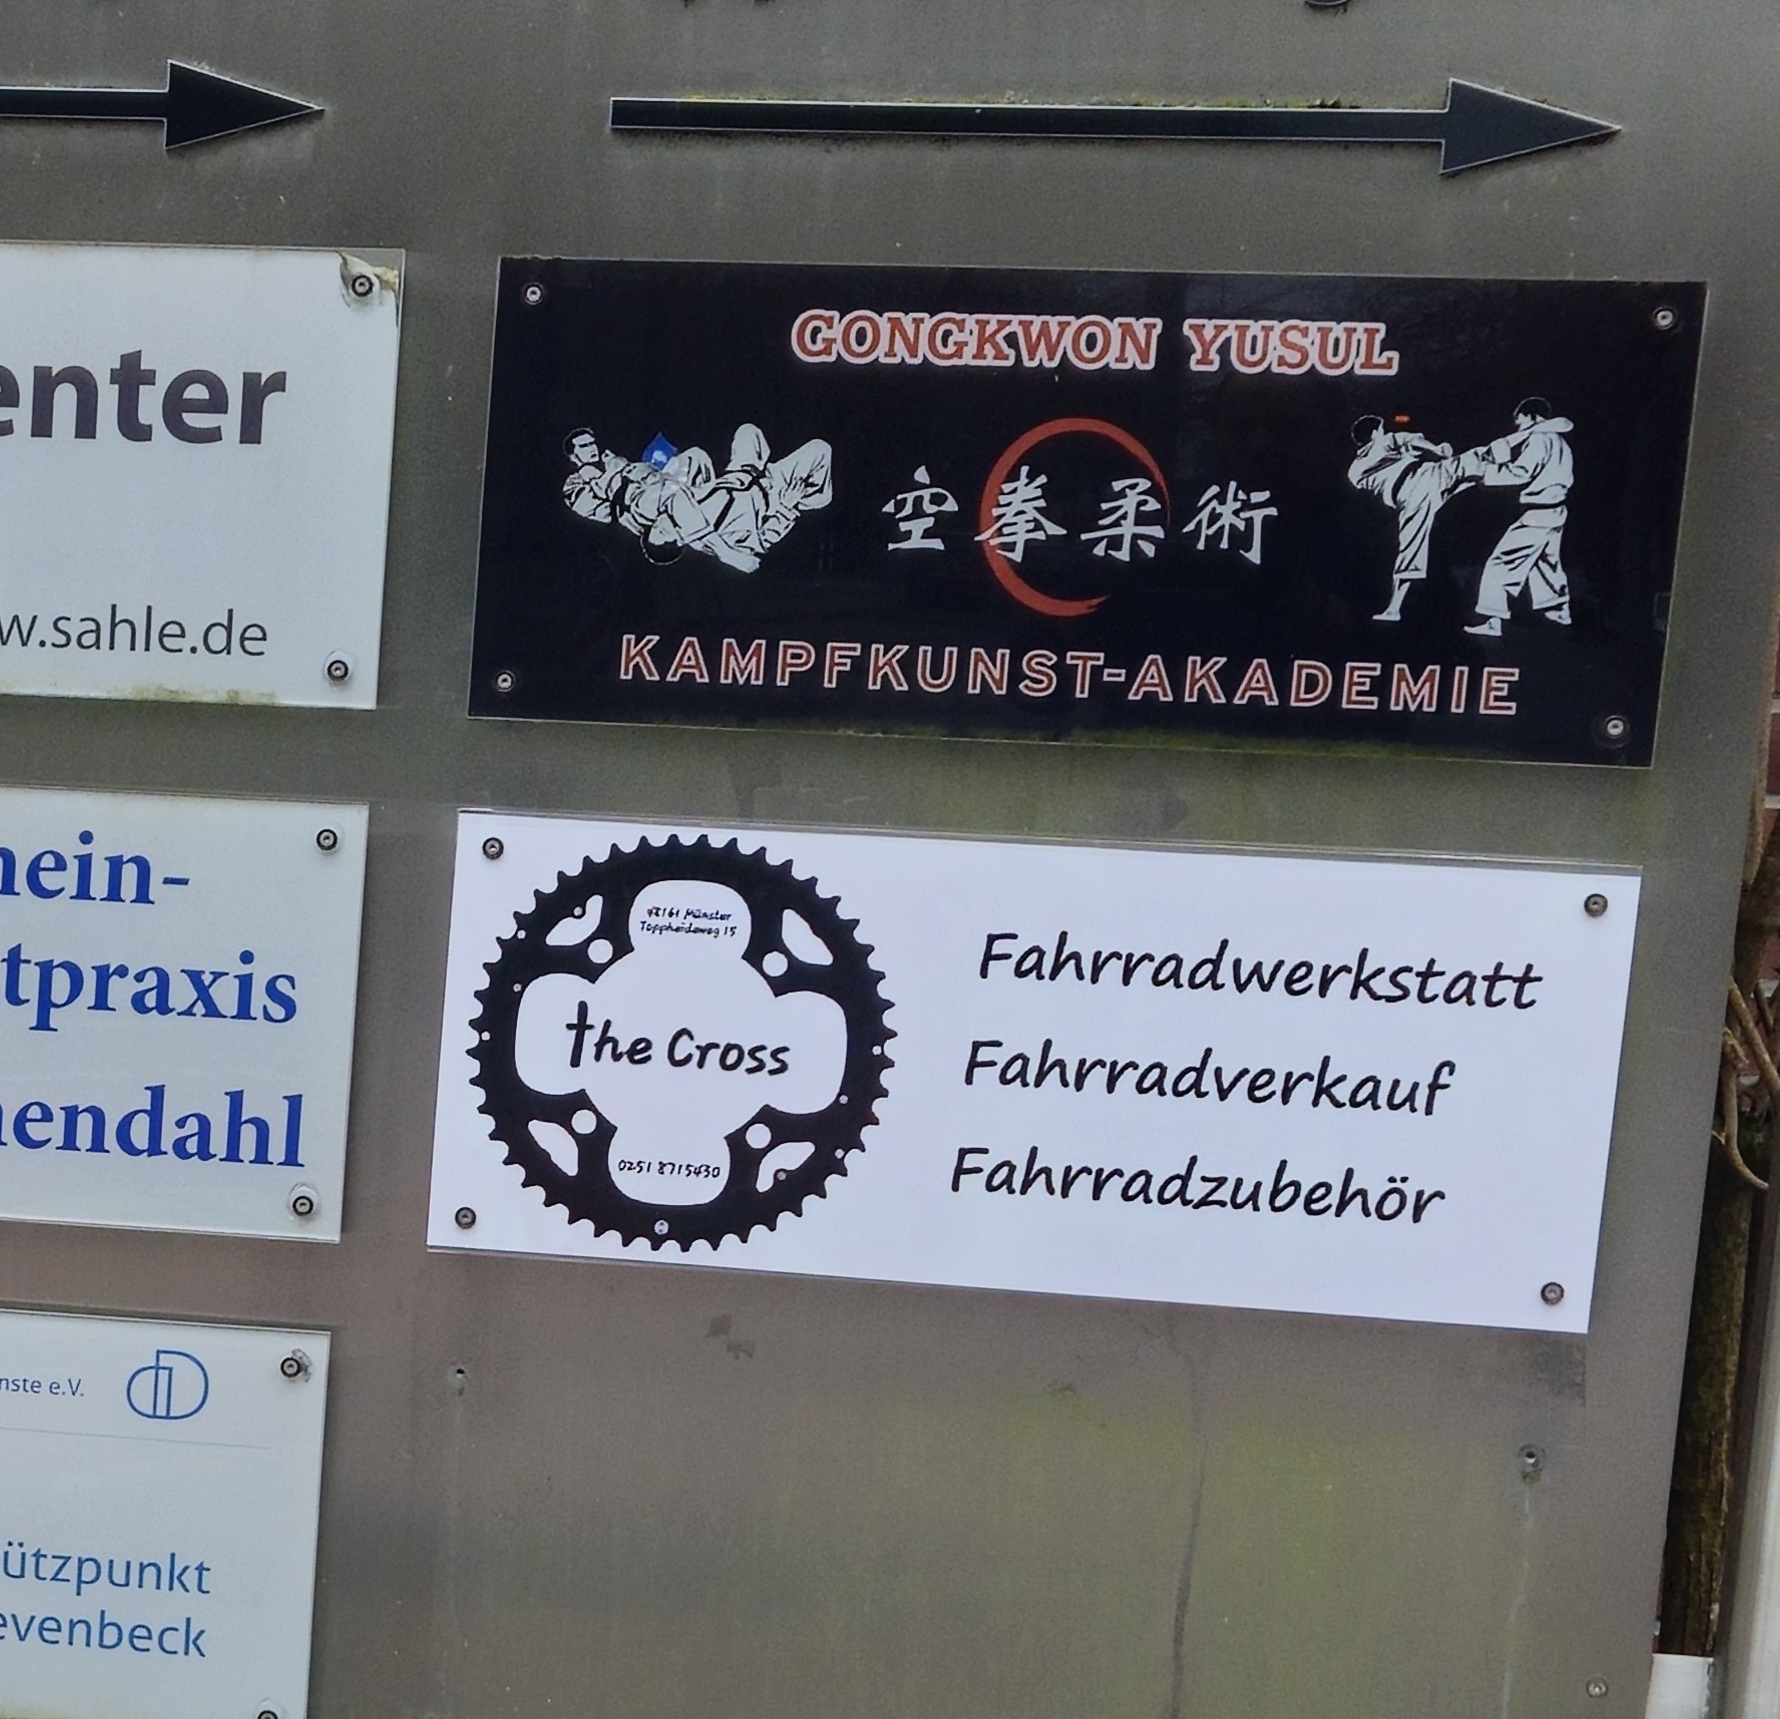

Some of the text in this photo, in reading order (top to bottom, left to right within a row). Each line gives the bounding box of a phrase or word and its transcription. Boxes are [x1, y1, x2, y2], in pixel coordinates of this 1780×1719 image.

[790, 307, 1399, 377] GONGKWON YUSUL
[881, 465, 1280, 566] 空拳柔術
[619, 634, 1522, 717] KAMPFKUNST-AKADEMIE
[724, 926, 737, 937] 15
[979, 930, 1545, 1011] Fahrradwerkstatt
[564, 1000, 791, 1077] the Cross
[964, 1038, 1457, 1115] Fahrradverkauf
[618, 1160, 651, 1173] 0251
[950, 1146, 1445, 1224] Fahrradzubehör
[48, 1376, 85, 1398] e.V.
